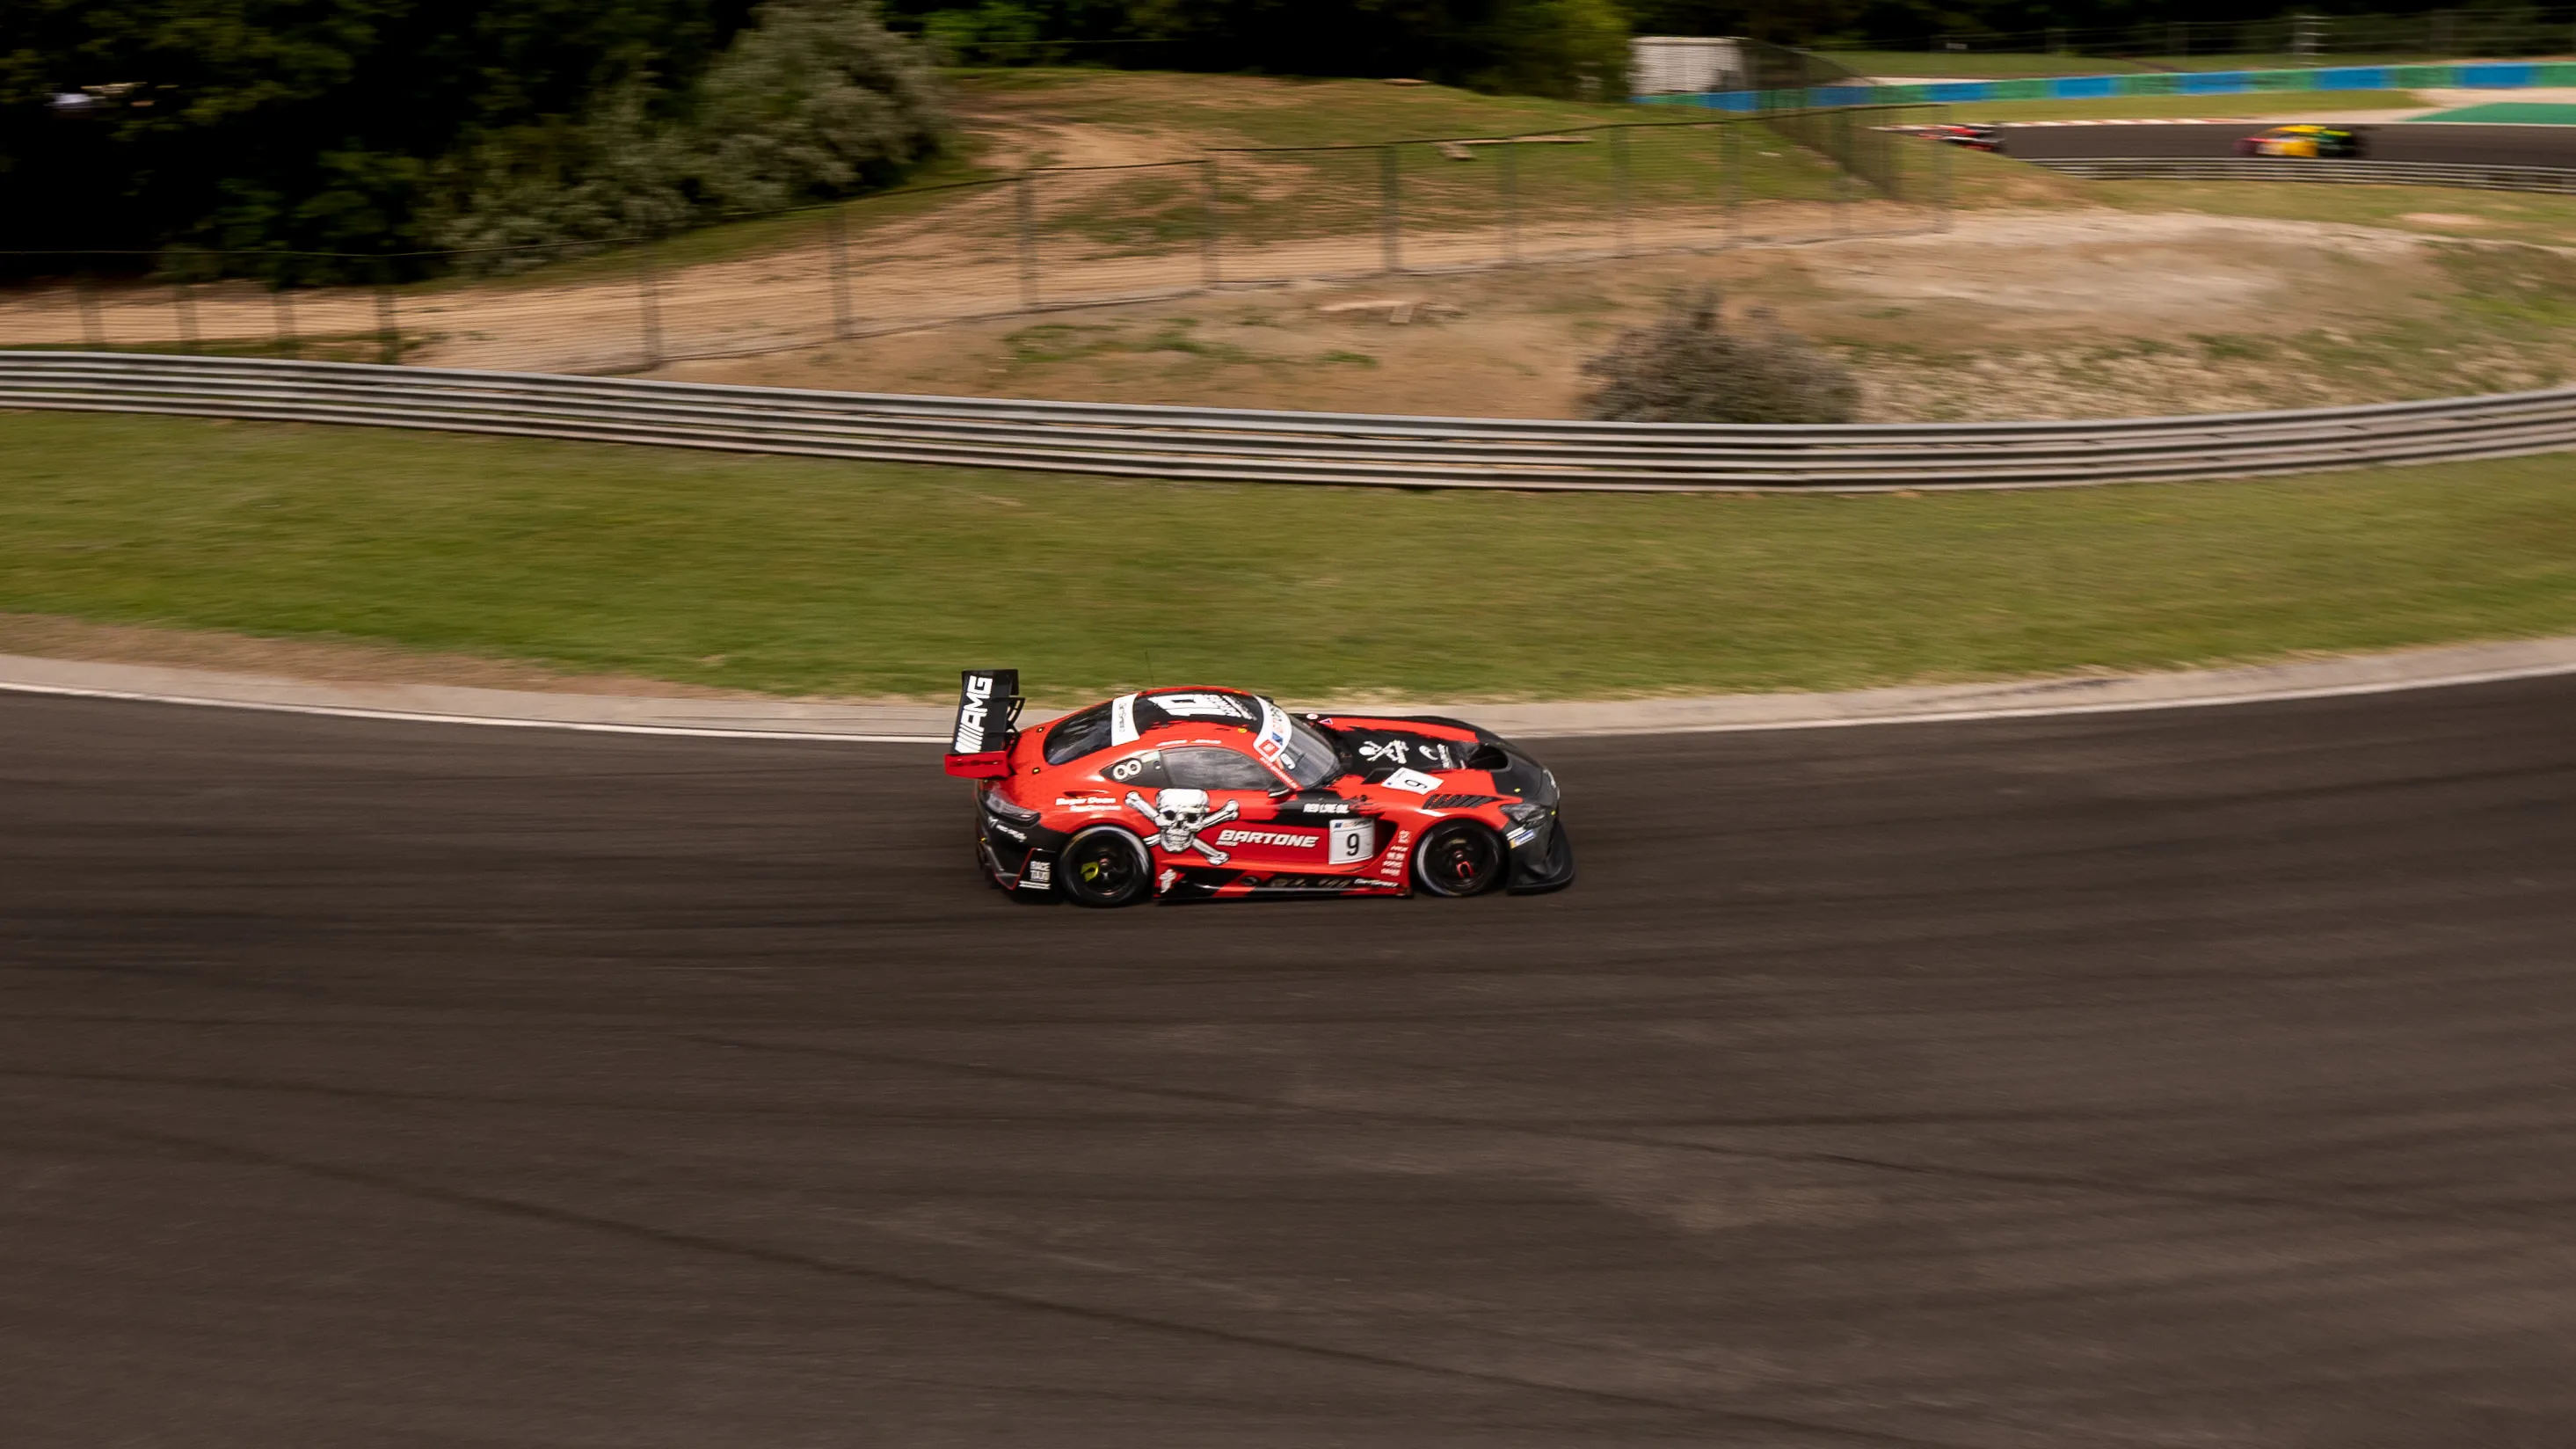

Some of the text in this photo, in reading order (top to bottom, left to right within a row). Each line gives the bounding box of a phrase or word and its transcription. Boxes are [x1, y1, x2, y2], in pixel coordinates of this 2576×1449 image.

[960, 675, 993, 732] AMG
[1218, 829, 1319, 848] BARTONE
[1346, 833, 1359, 856] 9
